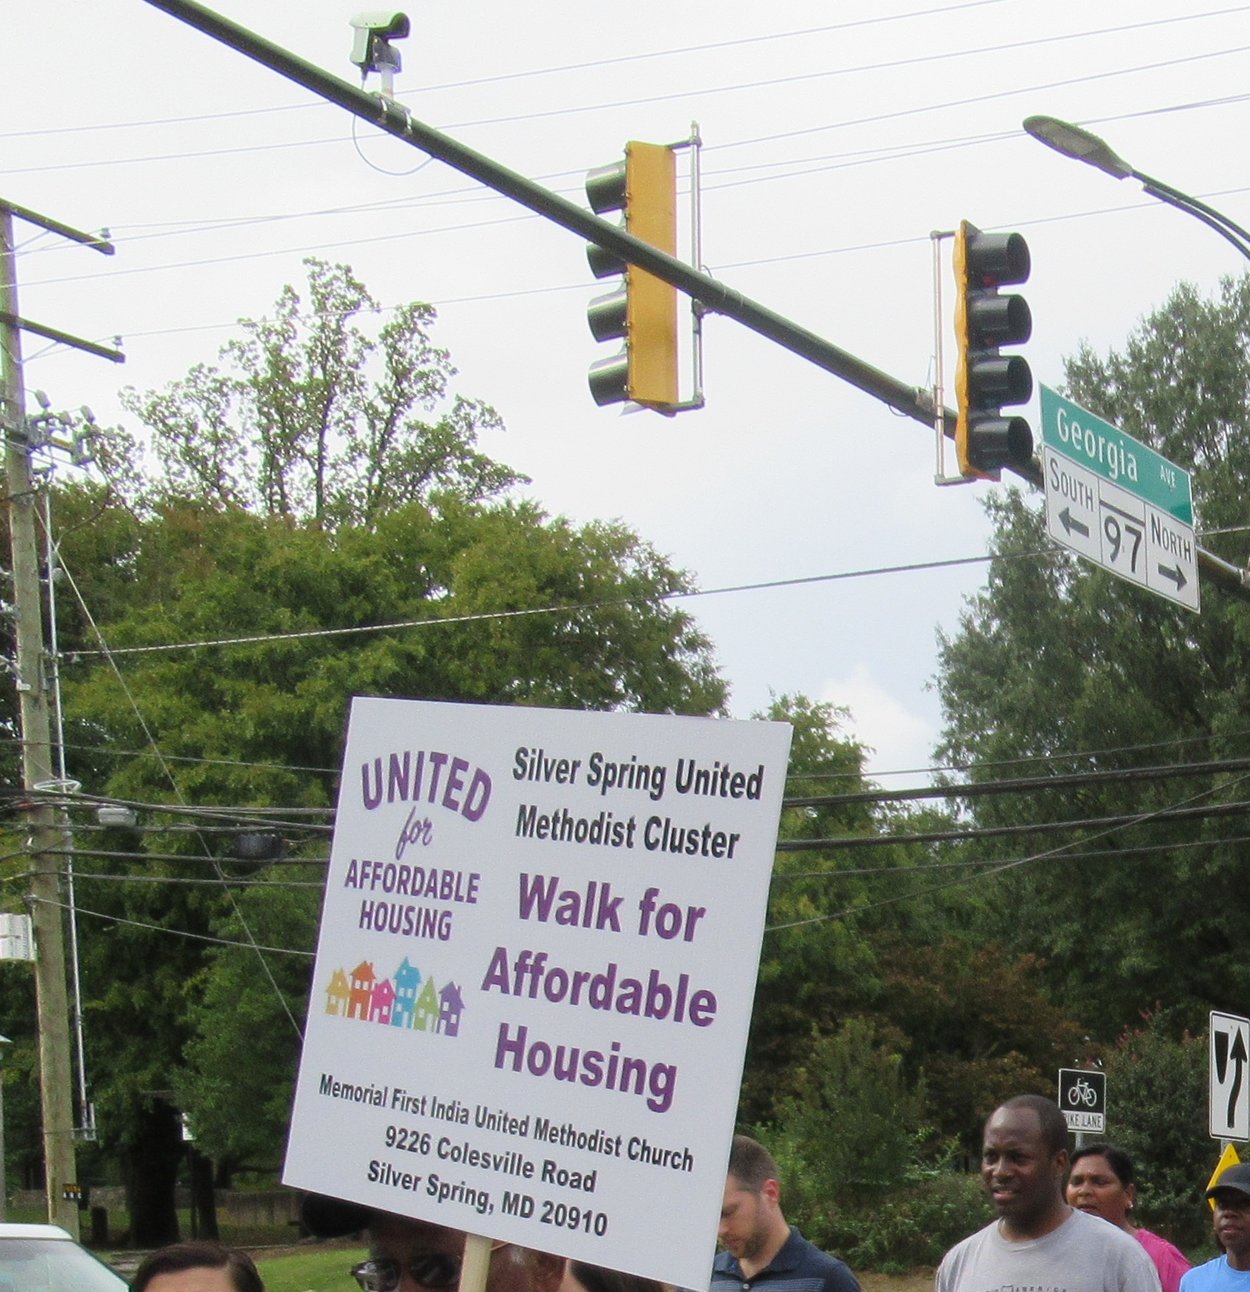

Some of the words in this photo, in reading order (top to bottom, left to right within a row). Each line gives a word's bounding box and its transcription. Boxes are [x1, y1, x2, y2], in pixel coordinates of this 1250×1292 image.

[1057, 408, 1138, 482] Georgia
[1160, 465, 1176, 489] AVE
[1050, 458, 1094, 512] SOUTH
[1104, 515, 1142, 574] 97
[1151, 513, 1192, 564] NORTH
[362, 751, 491, 822] UNITED
[513, 747, 581, 784] Silver
[587, 752, 667, 801] Spring
[675, 758, 764, 800] United
[395, 806, 432, 860] for
[515, 804, 636, 849] Methodist
[644, 816, 740, 859] Cluster
[344, 859, 480, 904] AFFORDABLE
[519, 873, 624, 932] Walk
[638, 887, 706, 942] for
[359, 900, 452, 941] HOUSING
[480, 947, 717, 1027] Affordable
[494, 1023, 677, 1114] Housing
[319, 1073, 388, 1107] Memorial
[391, 1088, 427, 1116] First
[431, 1096, 469, 1125] India
[475, 1105, 530, 1137] United
[534, 1117, 622, 1157] Methodist
[627, 1137, 693, 1172] Church
[1067, 1112, 1079, 1127] IKE
[1082, 1114, 1102, 1129] LANE
[385, 1126, 431, 1155] 9226
[437, 1137, 534, 1179] Colesville
[541, 1160, 597, 1193] Road
[367, 1160, 422, 1191] Silver
[426, 1174, 494, 1215] Spring,
[501, 1191, 535, 1220] MD
[540, 1200, 607, 1236] 20910
